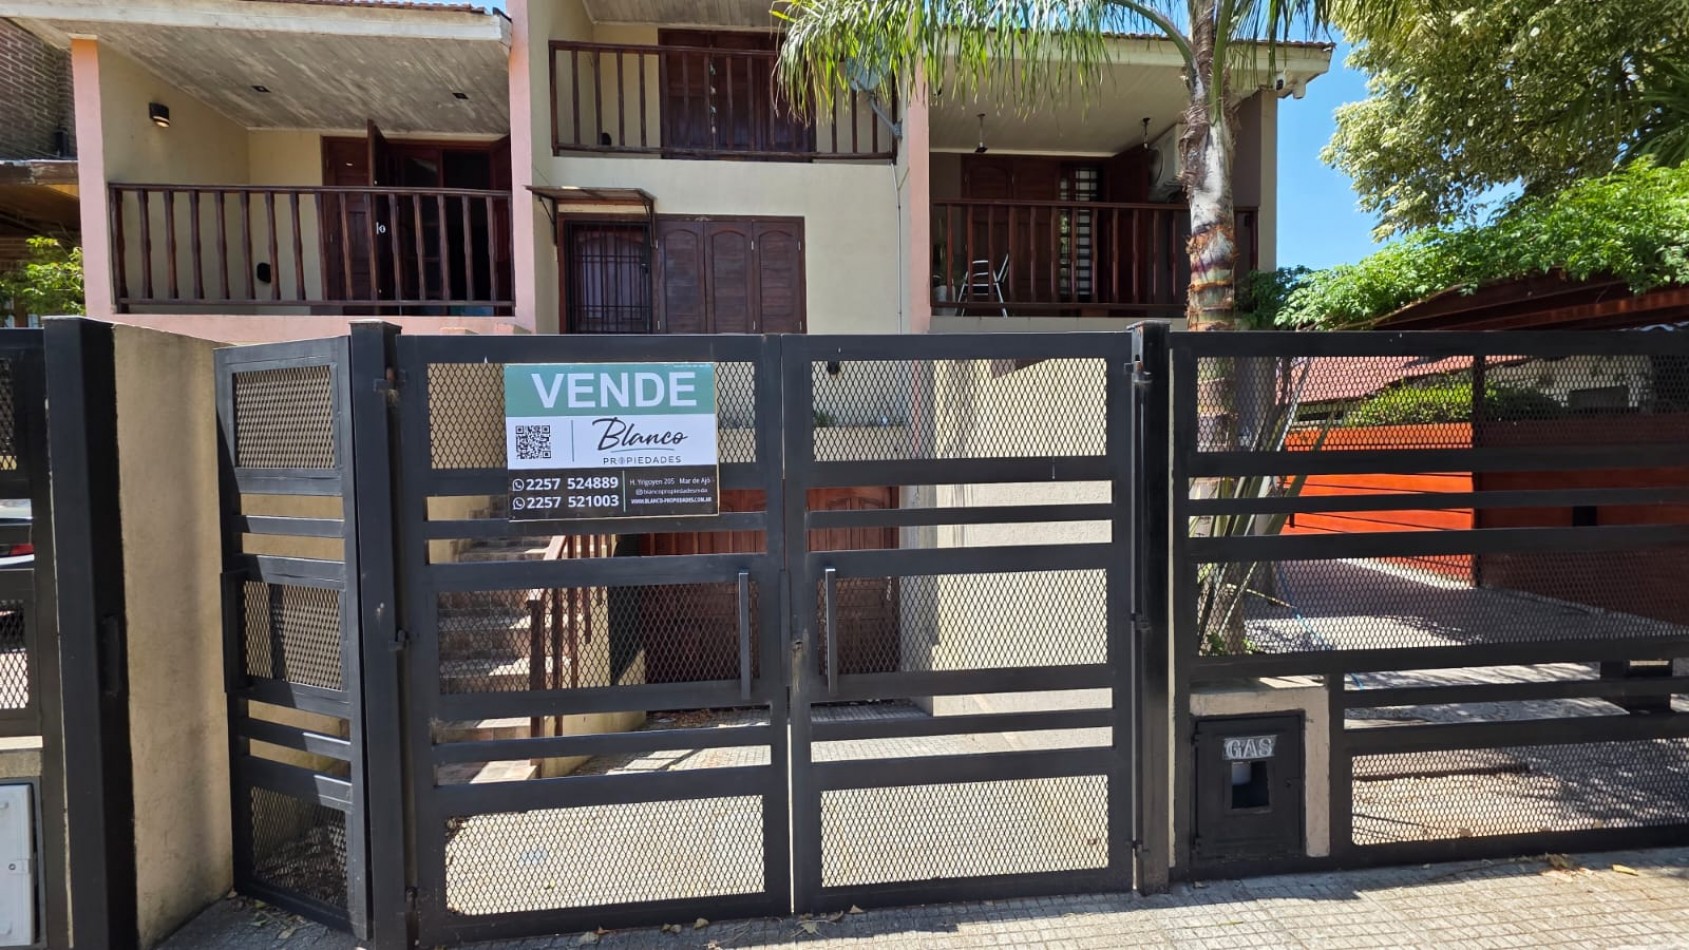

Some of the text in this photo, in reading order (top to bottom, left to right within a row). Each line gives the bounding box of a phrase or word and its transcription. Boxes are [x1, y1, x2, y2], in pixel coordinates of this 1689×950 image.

[532, 371, 697, 409] VENDE
[592, 417, 688, 451] Blanco
[603, 456, 682, 465] PROPIEDADES
[526, 476, 619, 491] 2257 524889
[527, 495, 619, 509] 2257 521003
[1226, 738, 1273, 759] GAS
